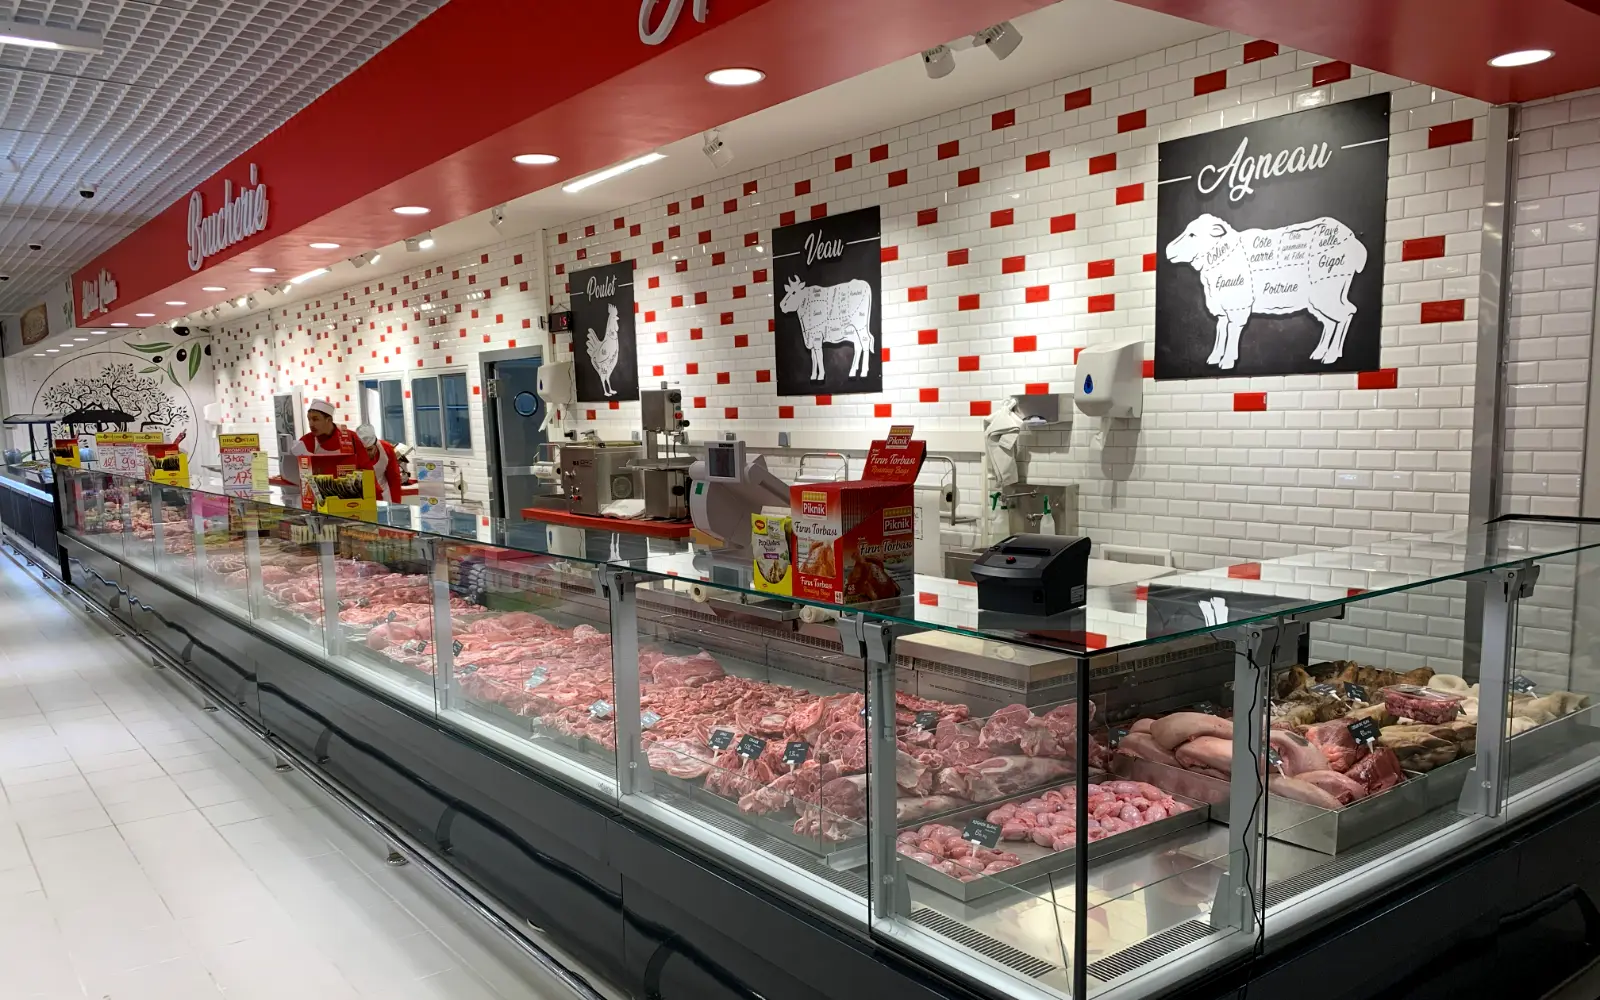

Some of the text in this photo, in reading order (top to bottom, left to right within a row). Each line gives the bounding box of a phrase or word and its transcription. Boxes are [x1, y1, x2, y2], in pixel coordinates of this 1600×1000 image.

[1197, 137, 1332, 202] Agneau
[187, 163, 269, 271] Boucherie
[804, 229, 844, 265] Veau
[1318, 253, 1345, 273] Gigot
[586, 274, 618, 302] Poulet
[1263, 281, 1299, 294] Poitrine
[887, 436, 909, 445] Piknik
[803, 502, 826, 515] Piknik
[885, 518, 910, 531] Piknik
